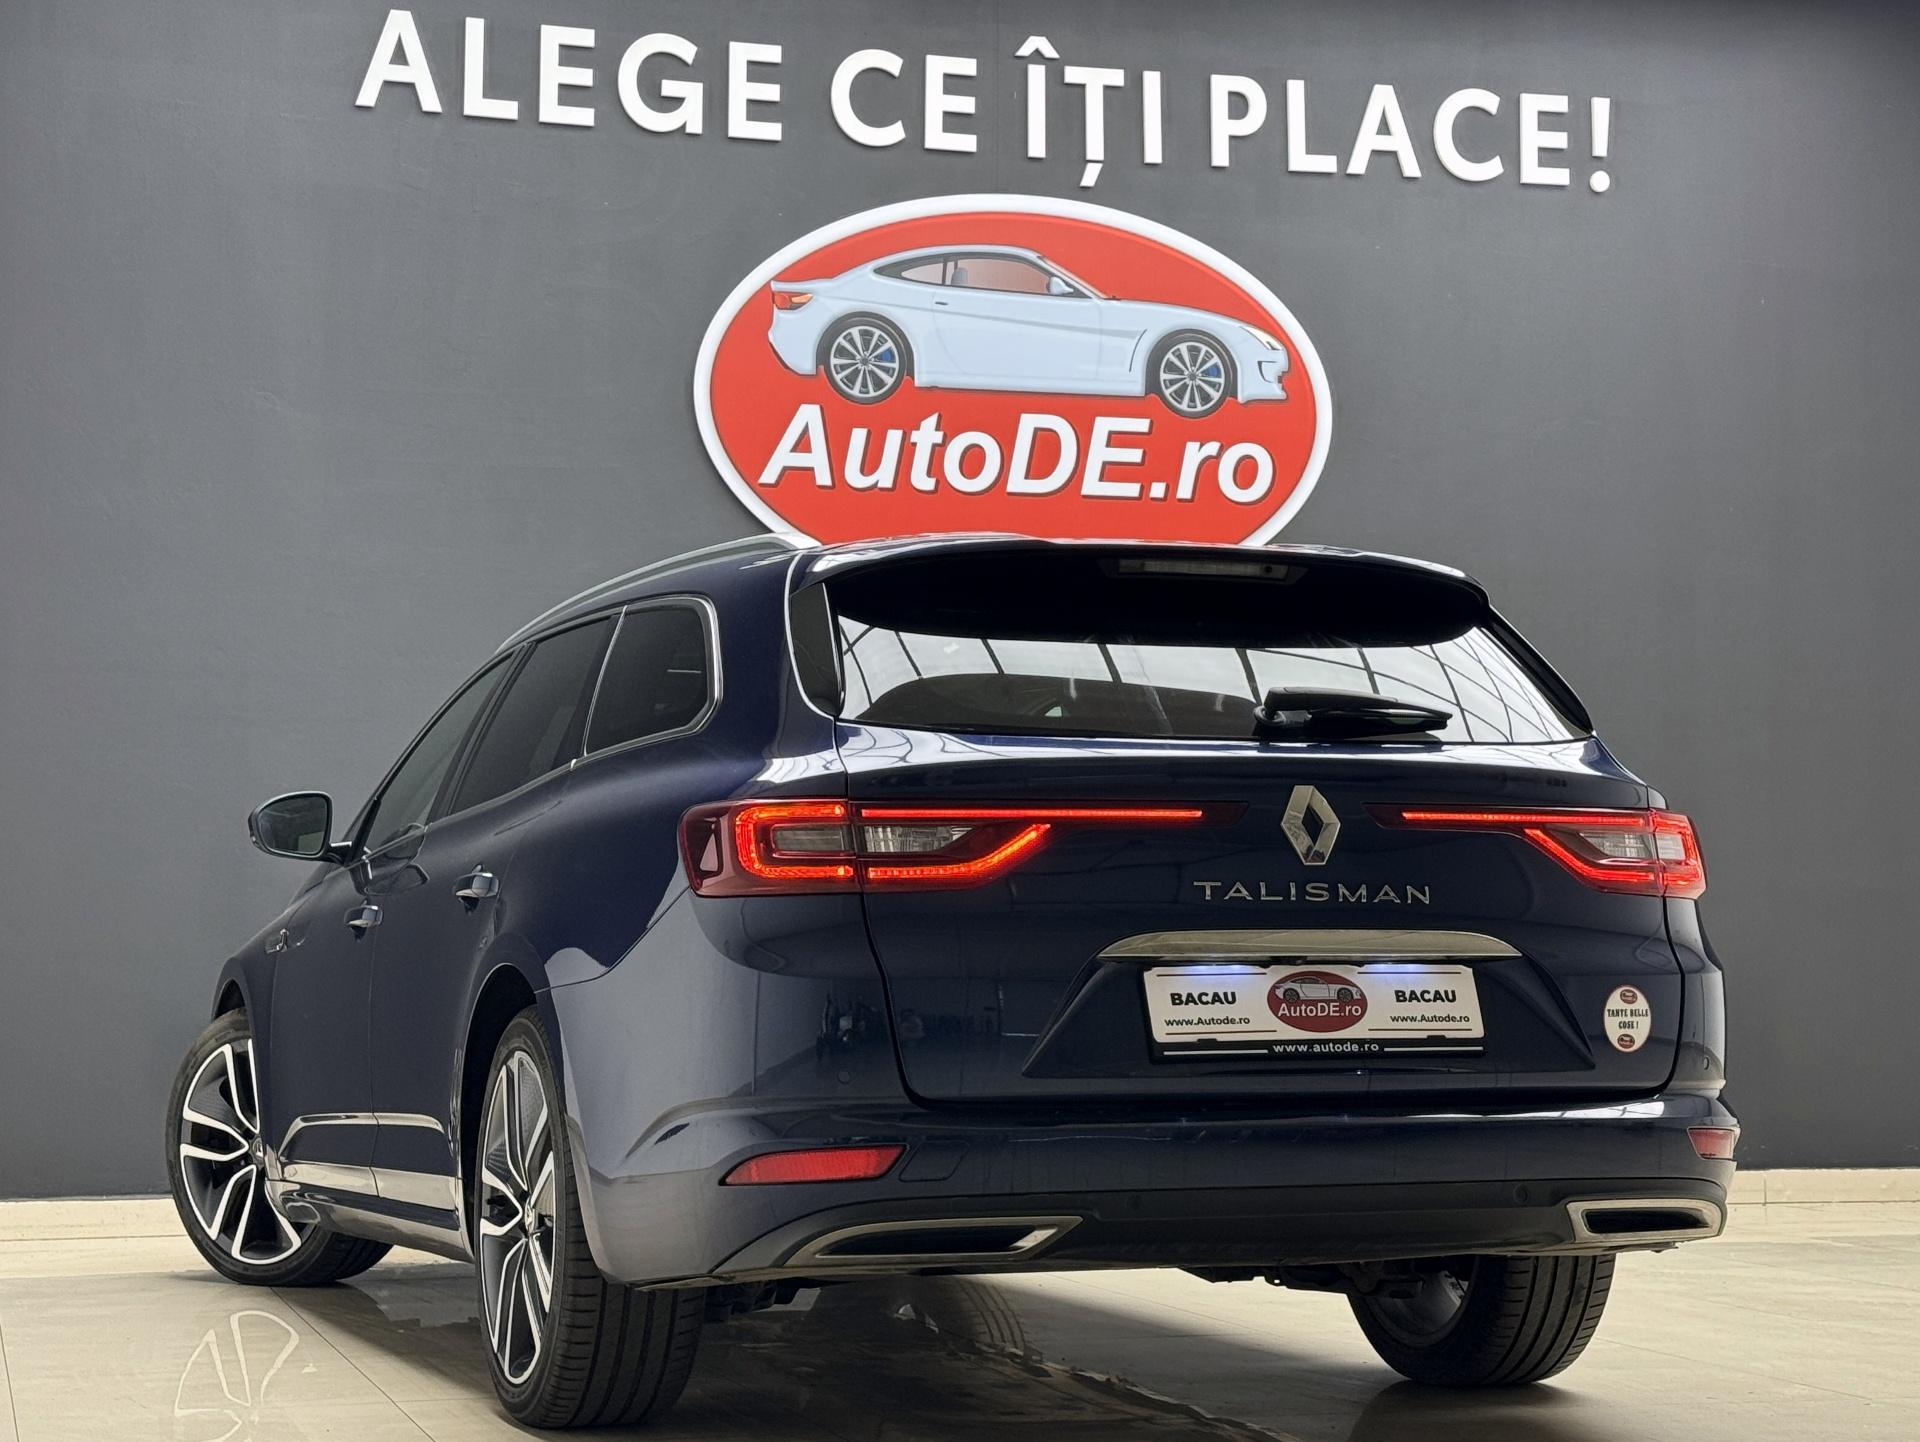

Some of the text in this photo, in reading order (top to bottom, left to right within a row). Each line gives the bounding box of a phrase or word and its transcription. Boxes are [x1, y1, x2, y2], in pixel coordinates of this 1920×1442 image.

[355, 9, 784, 142] ALEGE
[830, 49, 978, 153] CE
[1210, 73, 1612, 194] PLACE!
[758, 403, 1276, 504] AutoDE.ro
[1193, 881, 1431, 905] TALISMAN
[1170, 991, 1237, 1006] BACAU
[1394, 989, 1457, 1004] BACAU
[1277, 1002, 1362, 1018] AutoDE.ro
[1607, 1008, 1649, 1018] TANTE BELLE
[1164, 1015, 1251, 1027] www.Autode.ro
[1389, 1013, 1471, 1024] www.Autode.ro
[1272, 1041, 1380, 1054] www.autode.ro
